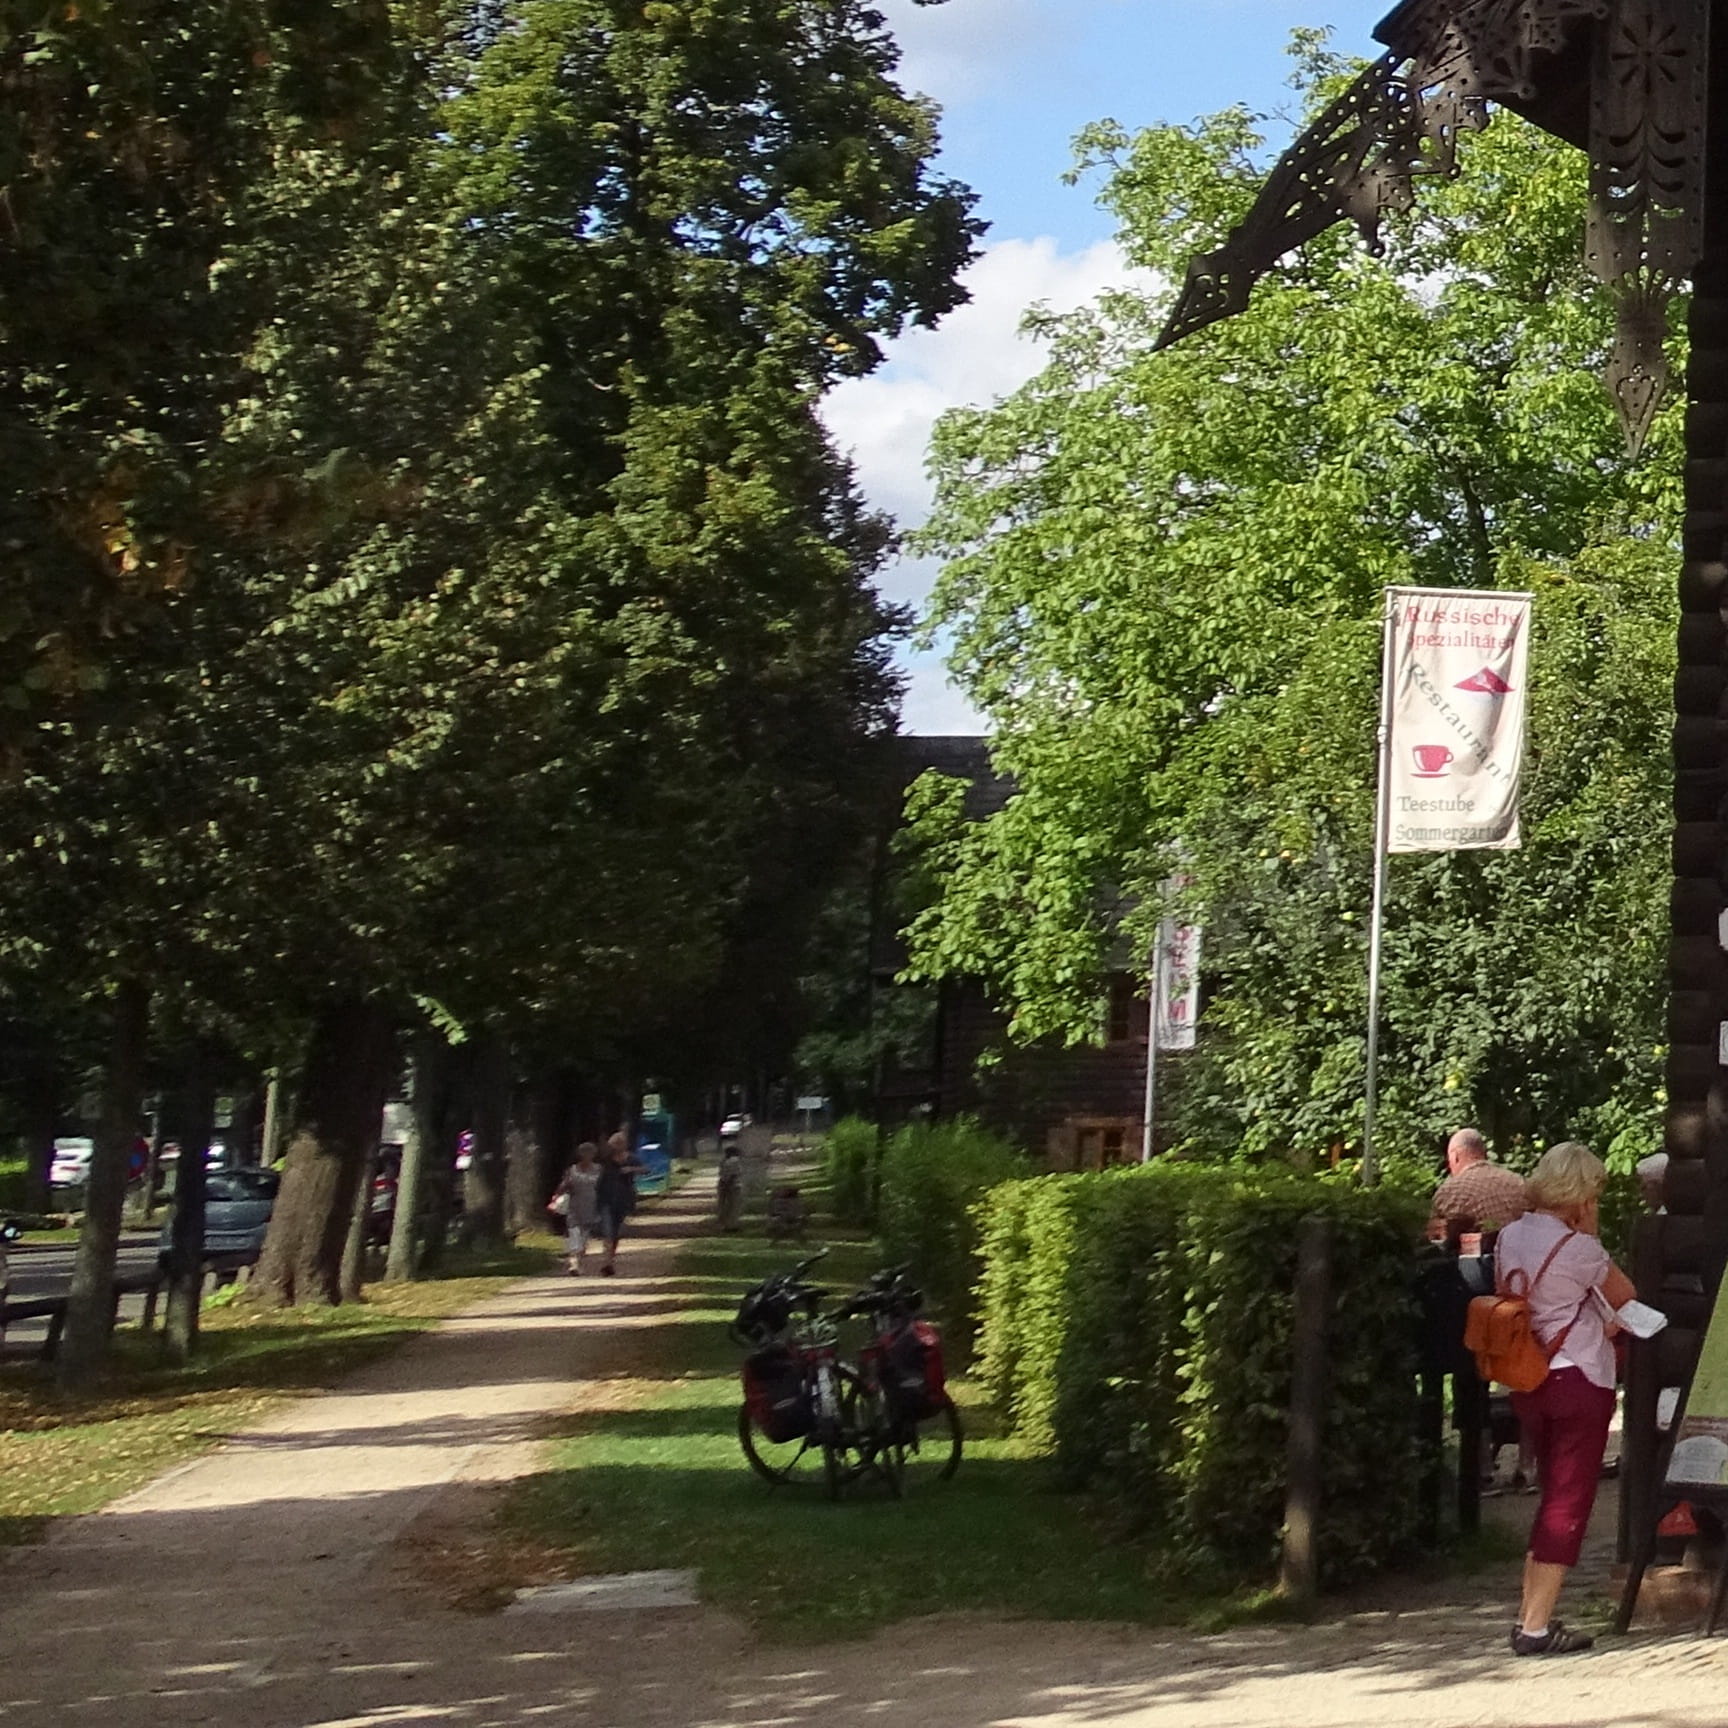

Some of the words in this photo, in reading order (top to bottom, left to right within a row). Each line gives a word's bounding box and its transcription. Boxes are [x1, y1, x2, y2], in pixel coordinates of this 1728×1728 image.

[1407, 606, 1520, 626] Russische
[1409, 662, 1511, 784] Restaurant
[1397, 794, 1475, 812] Teestube
[1395, 824, 1508, 845] Sommergarten
